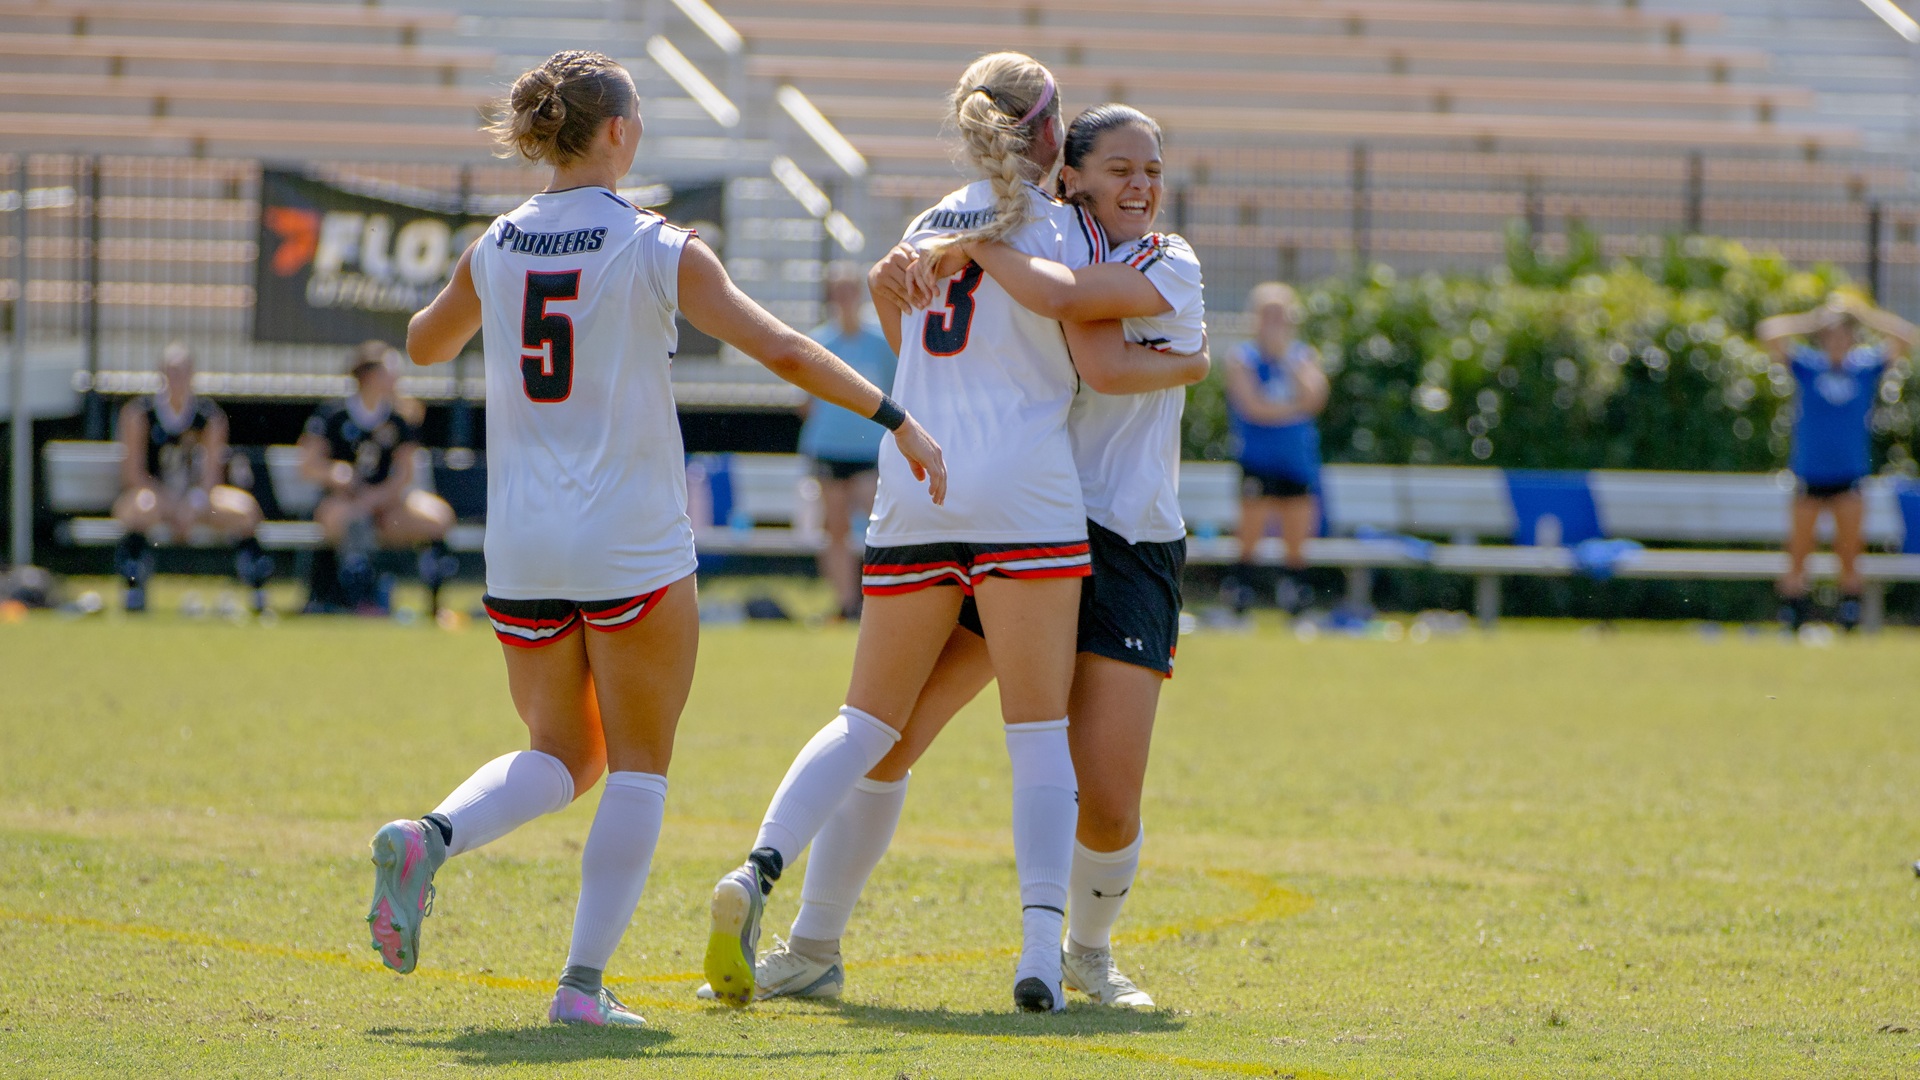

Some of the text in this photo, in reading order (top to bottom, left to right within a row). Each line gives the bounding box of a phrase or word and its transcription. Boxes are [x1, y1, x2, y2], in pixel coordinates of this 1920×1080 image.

[496, 223, 608, 256] PIONEERS
[520, 269, 582, 403] 5
[922, 258, 984, 357] 3
